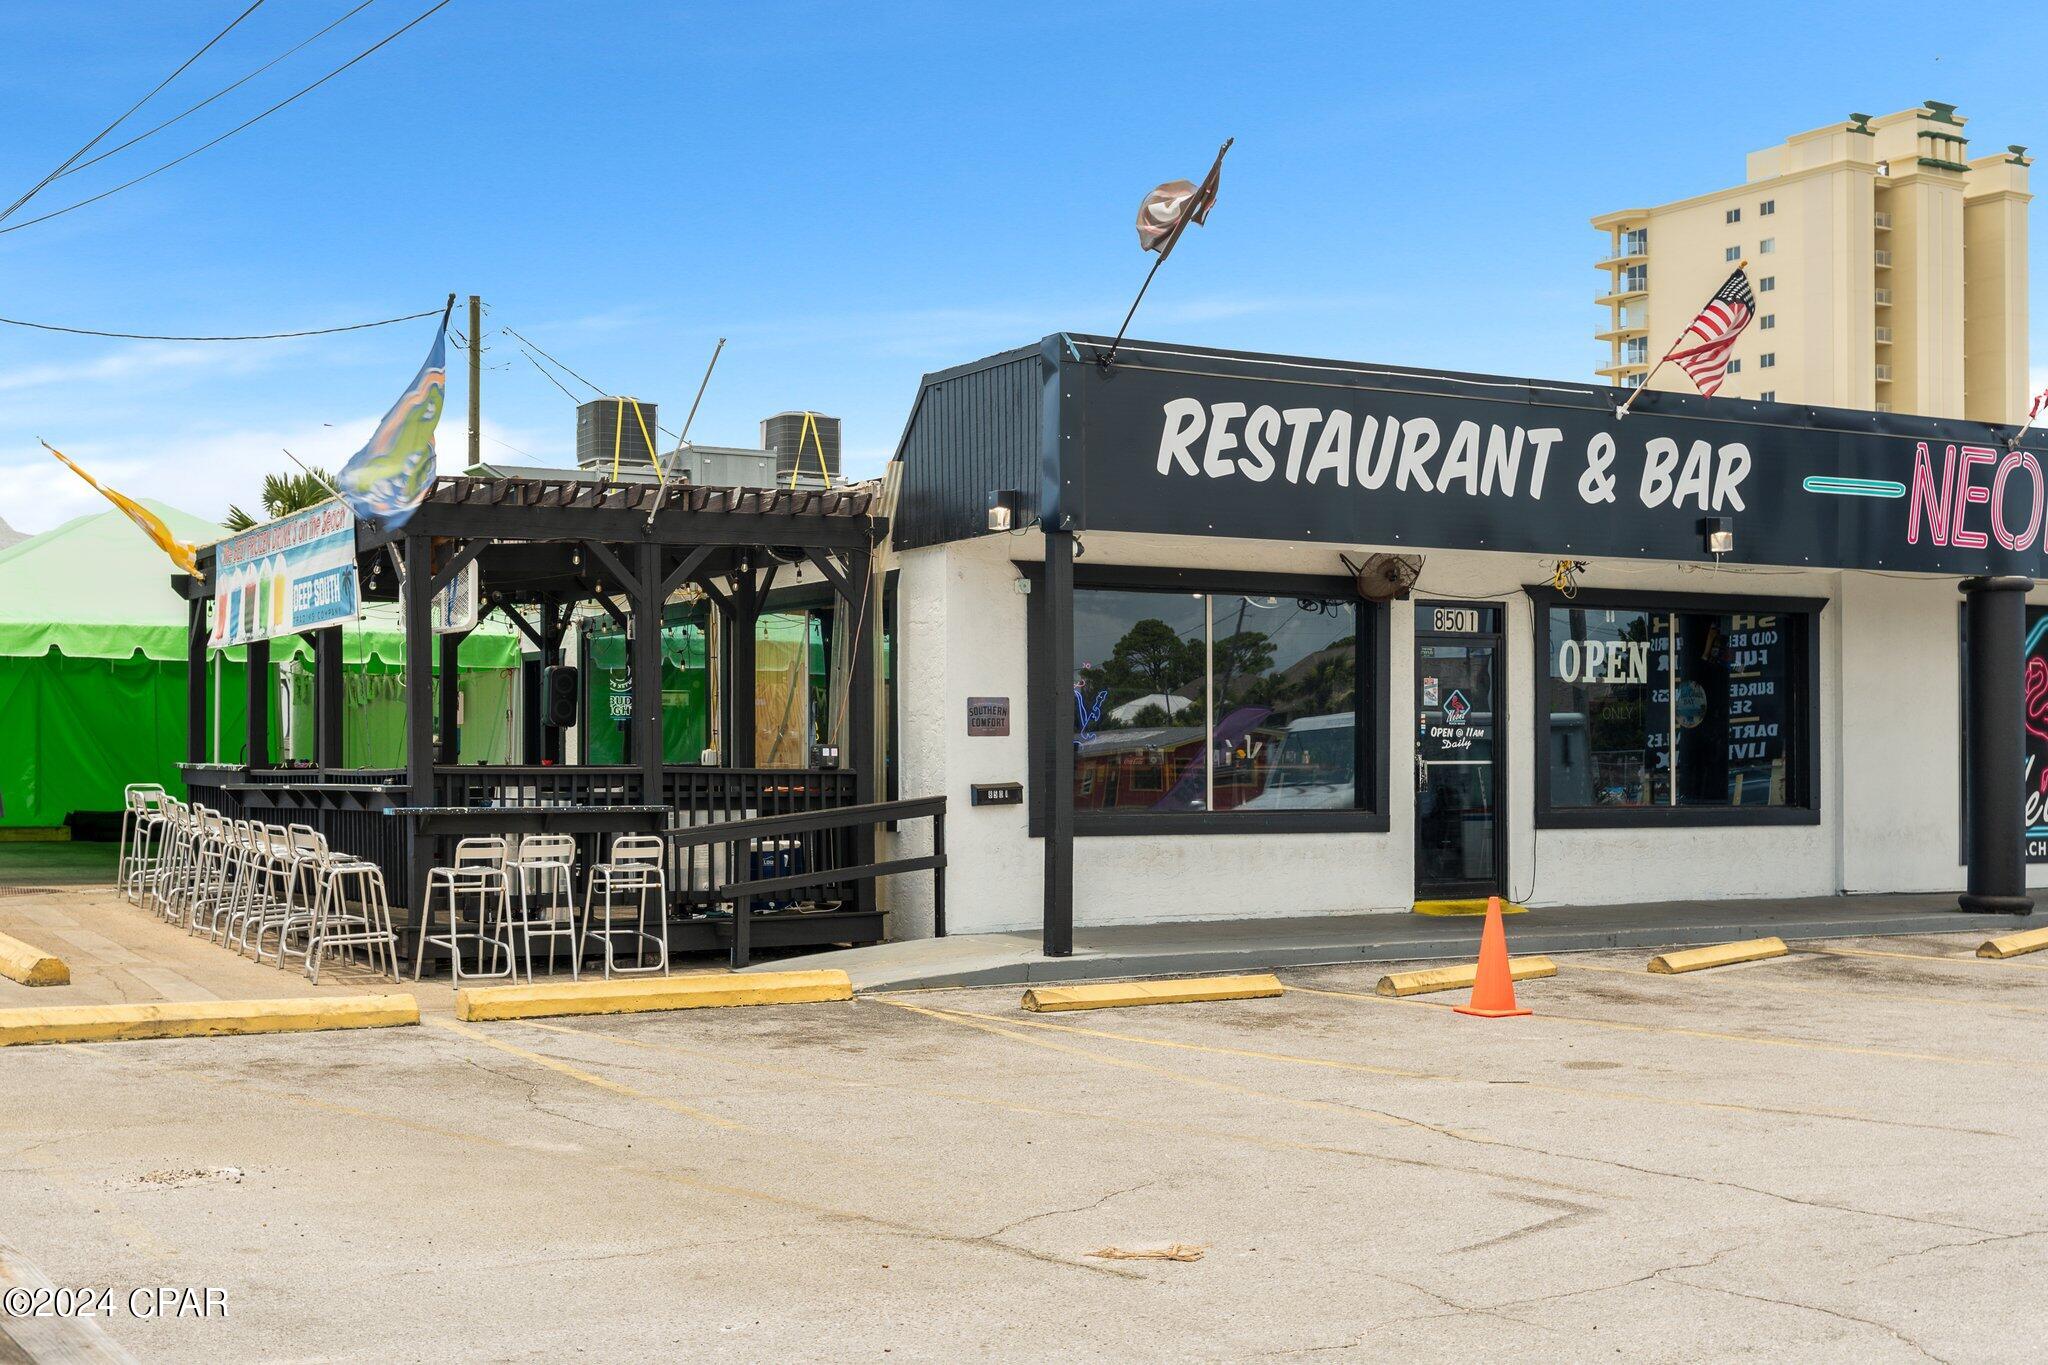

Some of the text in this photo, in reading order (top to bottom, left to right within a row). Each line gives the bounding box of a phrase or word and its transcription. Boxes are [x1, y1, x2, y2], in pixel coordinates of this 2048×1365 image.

[1156, 398, 1752, 512] RESTAURANT & BAR
[1908, 442, 2048, 554] NEO
[293, 573, 340, 612] DEEP SOUTH
[1435, 609, 1474, 631] 8501
[1559, 639, 1650, 684] OPEN
[968, 705, 1008, 717] SOUTHERN
[1602, 705, 1633, 721] ONLY
[971, 718, 1005, 727] COMFORT
[1430, 726, 1454, 738] OPEN
[1455, 728, 1464, 737] @
[1441, 737, 1471, 749] Daily
[2025, 841, 2047, 856] CH
